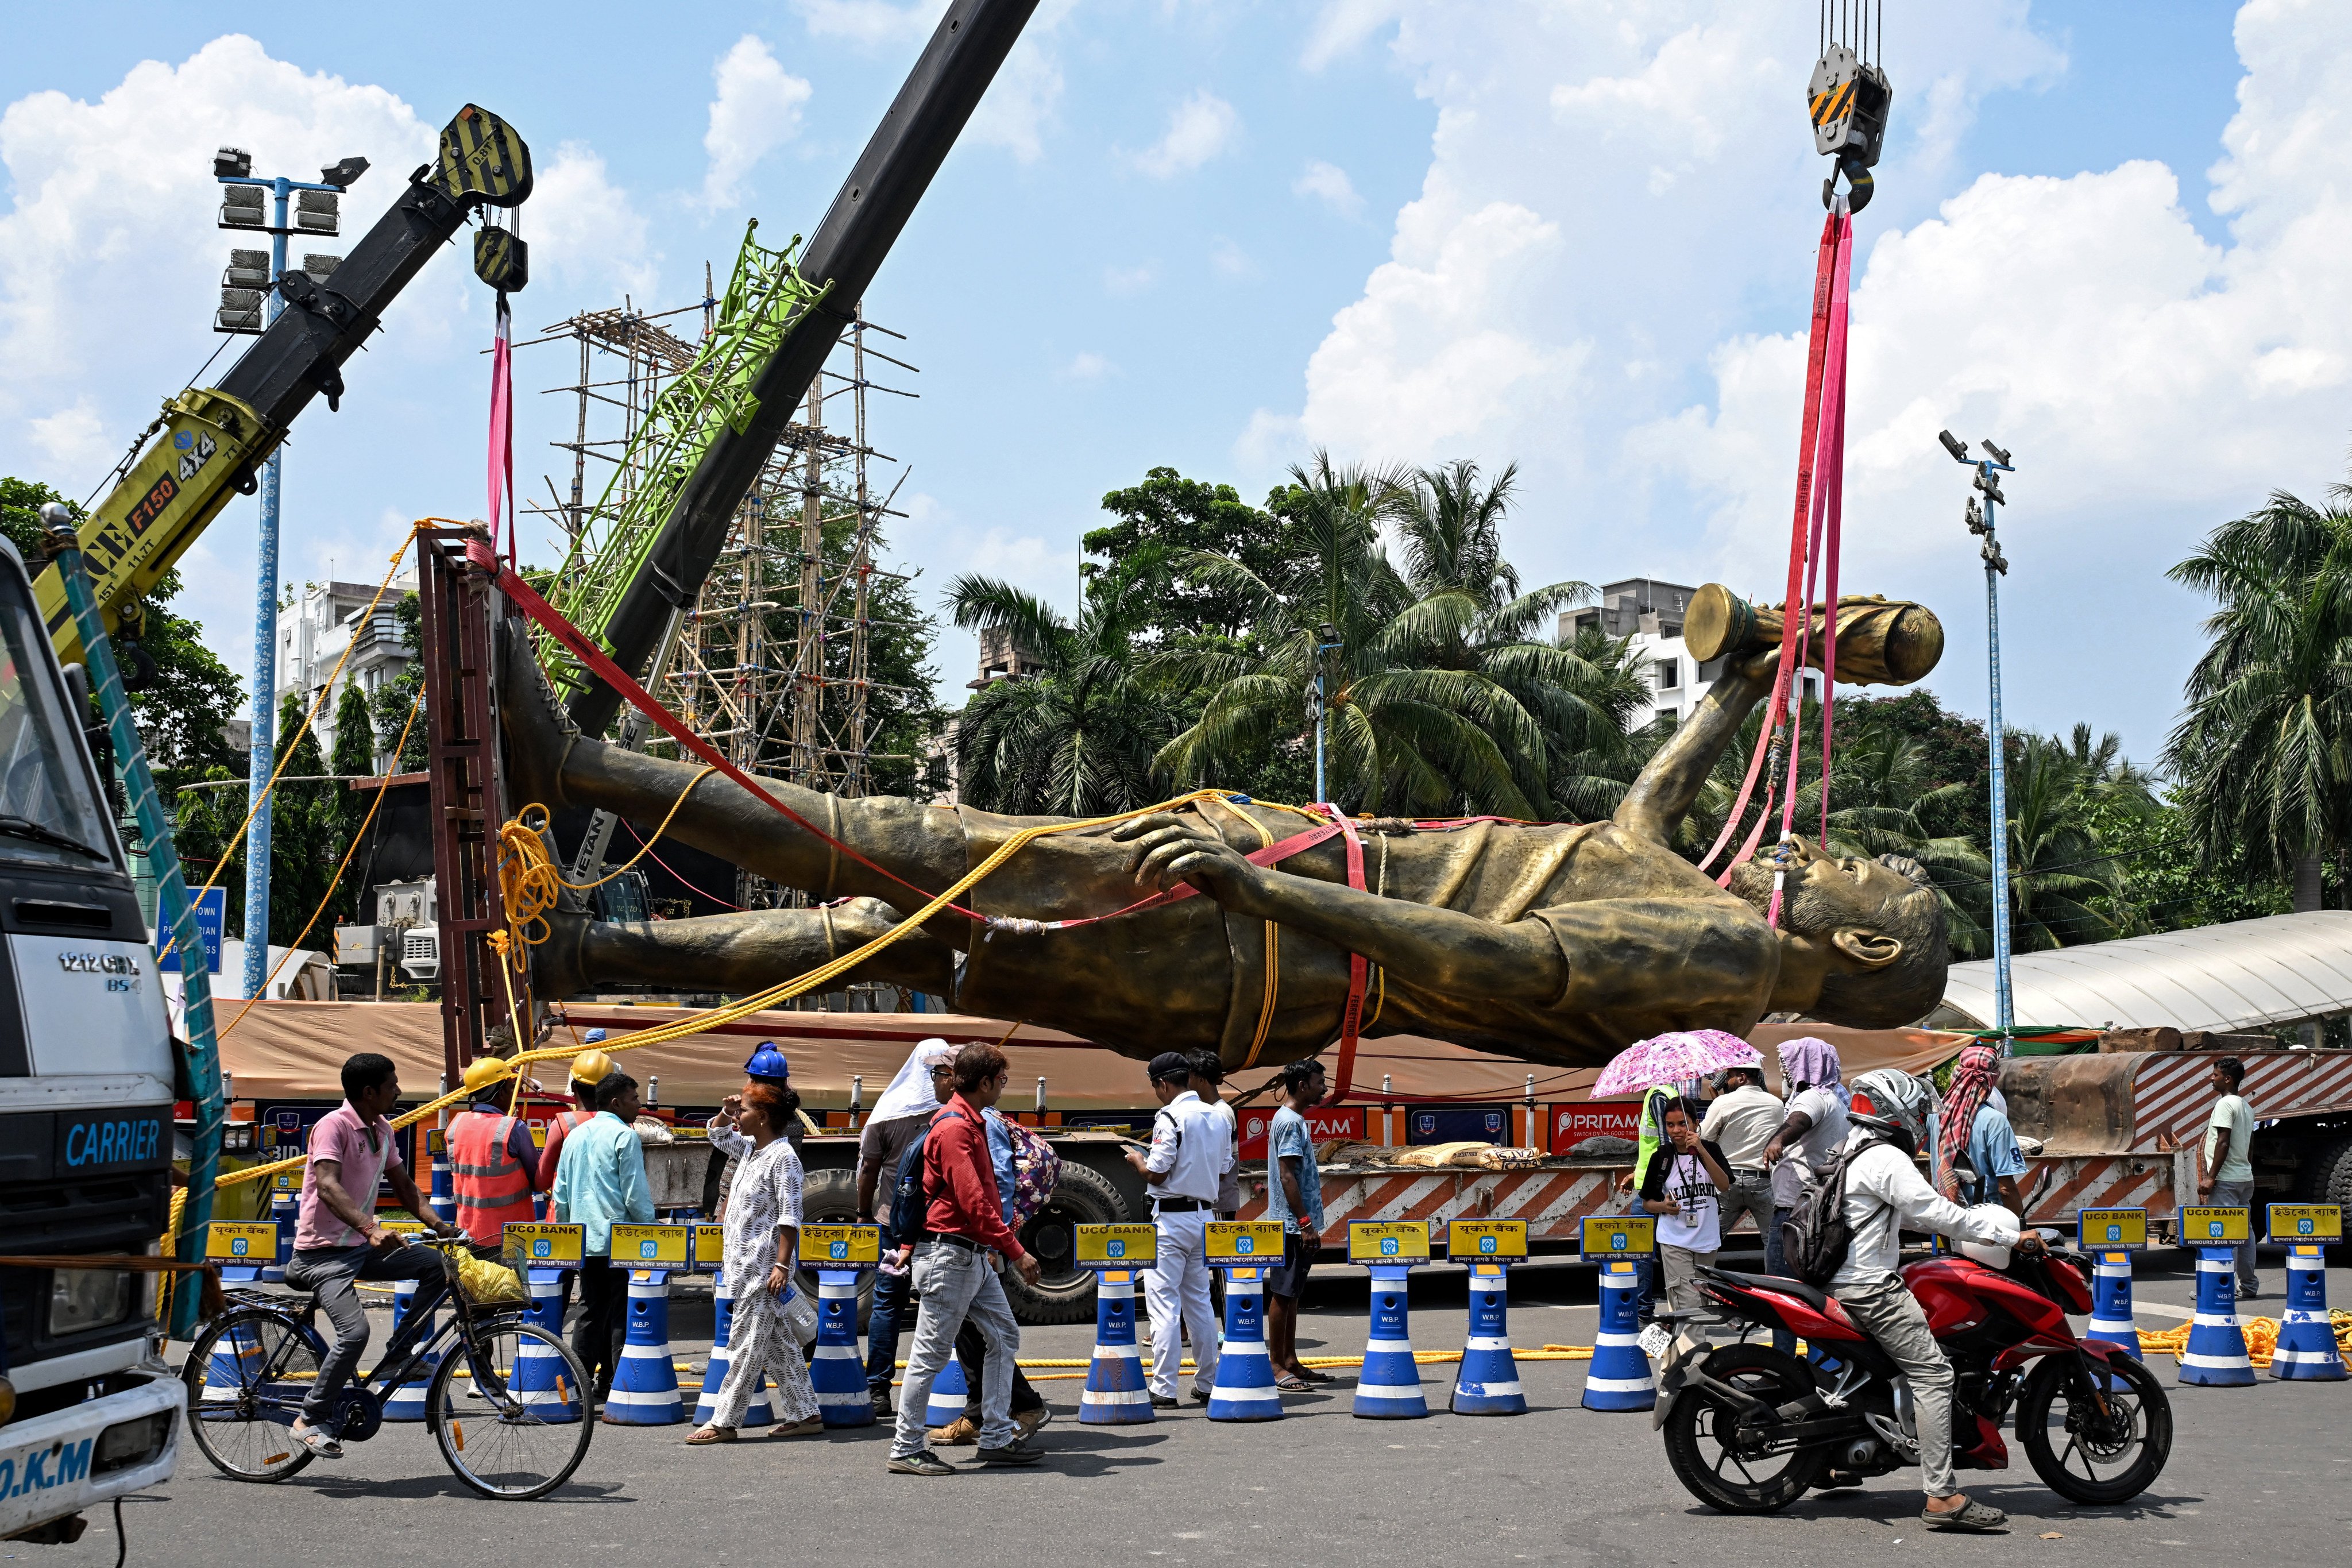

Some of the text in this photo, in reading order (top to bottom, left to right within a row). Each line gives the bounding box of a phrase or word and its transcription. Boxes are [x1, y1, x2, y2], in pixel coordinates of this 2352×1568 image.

[223, 445, 238, 460] 7T
[132, 480, 173, 531] F150
[128, 538, 155, 569] 11.7T
[98, 581, 118, 602] 15T
[1346, 995, 1360, 1037] FERRETERRO
[1574, 1114, 1639, 1129] PRITAM
[66, 1119, 160, 1167] CARRIER
[2273, 1207, 2338, 1216] ইউকো ব্যাঙ্ক
[214, 1225, 269, 1236] यूको बैंक
[507, 1225, 579, 1234] UCO BANK
[613, 1225, 685, 1239] ইউকো ব্যাঙ্ক
[1114, 1226, 1152, 1234] BANK
[1208, 1223, 1281, 1234] ইউকো ব্যাঙ্ক
[1360, 1224, 1420, 1237] यूको बैंक
[1459, 1223, 1519, 1235] यूको बैंक
[1594, 1220, 1647, 1231] यूको बैंक
[802, 1226, 877, 1239] ইউকো ব্যাঙ্ক
